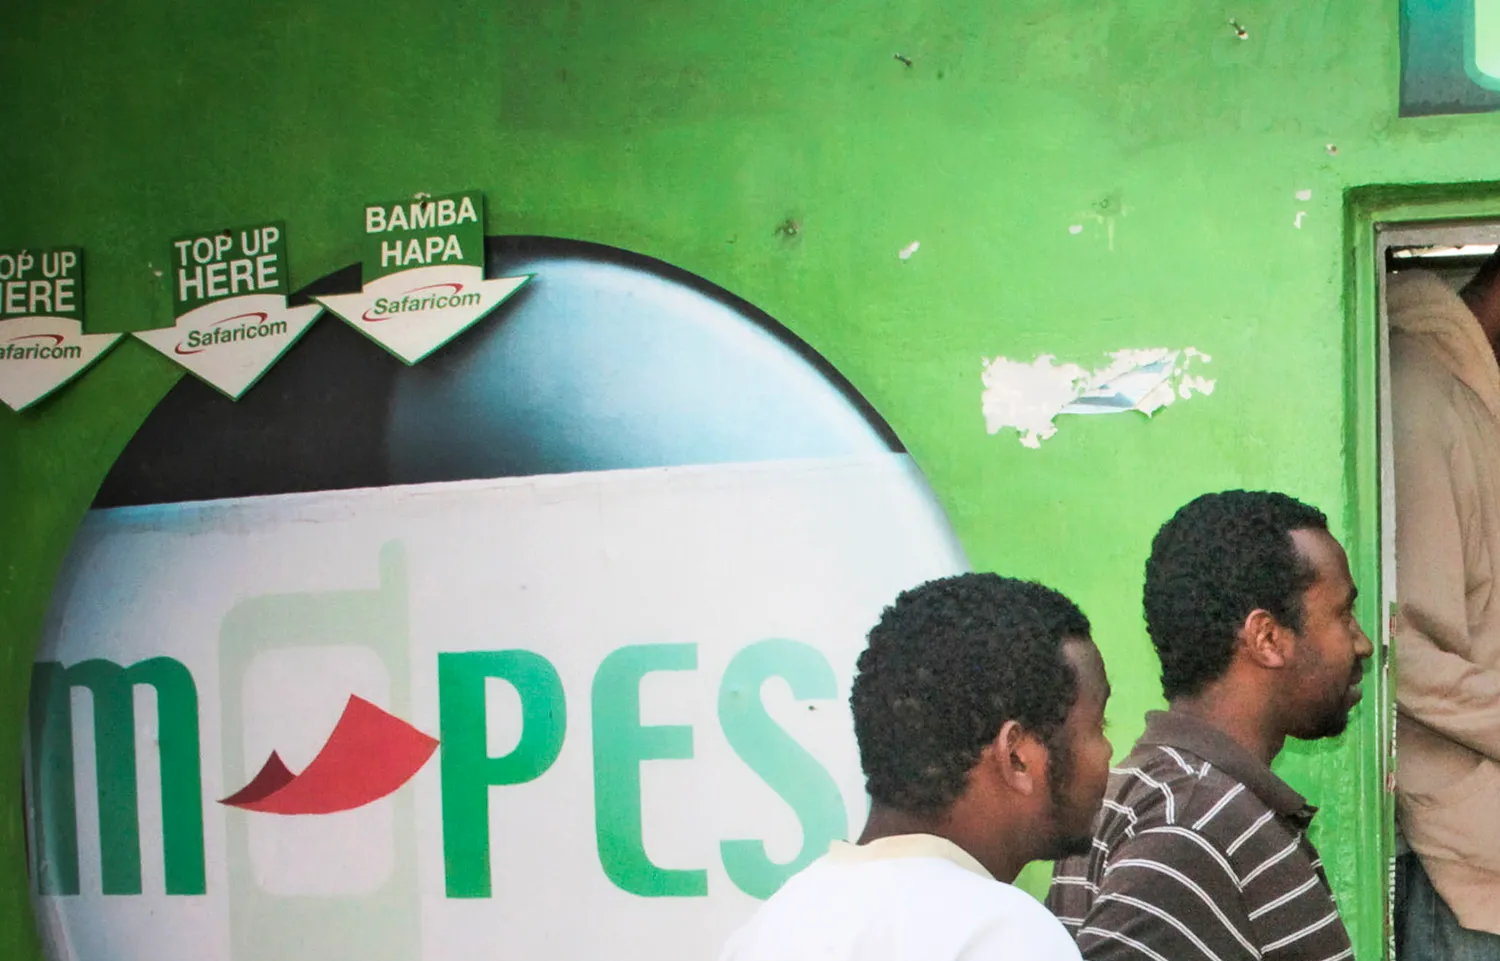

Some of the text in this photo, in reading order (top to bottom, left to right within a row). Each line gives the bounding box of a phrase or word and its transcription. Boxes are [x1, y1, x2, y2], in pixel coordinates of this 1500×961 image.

[366, 197, 477, 233] BAMBA
[175, 227, 279, 265] TOP UP
[380, 235, 463, 267] HAPA
[0, 252, 76, 280] OP UP
[178, 255, 280, 302] HERE
[0, 279, 76, 313] ERE
[373, 289, 481, 316] Safaricom
[186, 319, 288, 349] Safaricom
[0, 343, 82, 361] afaricom
[437, 637, 851, 902] PES
